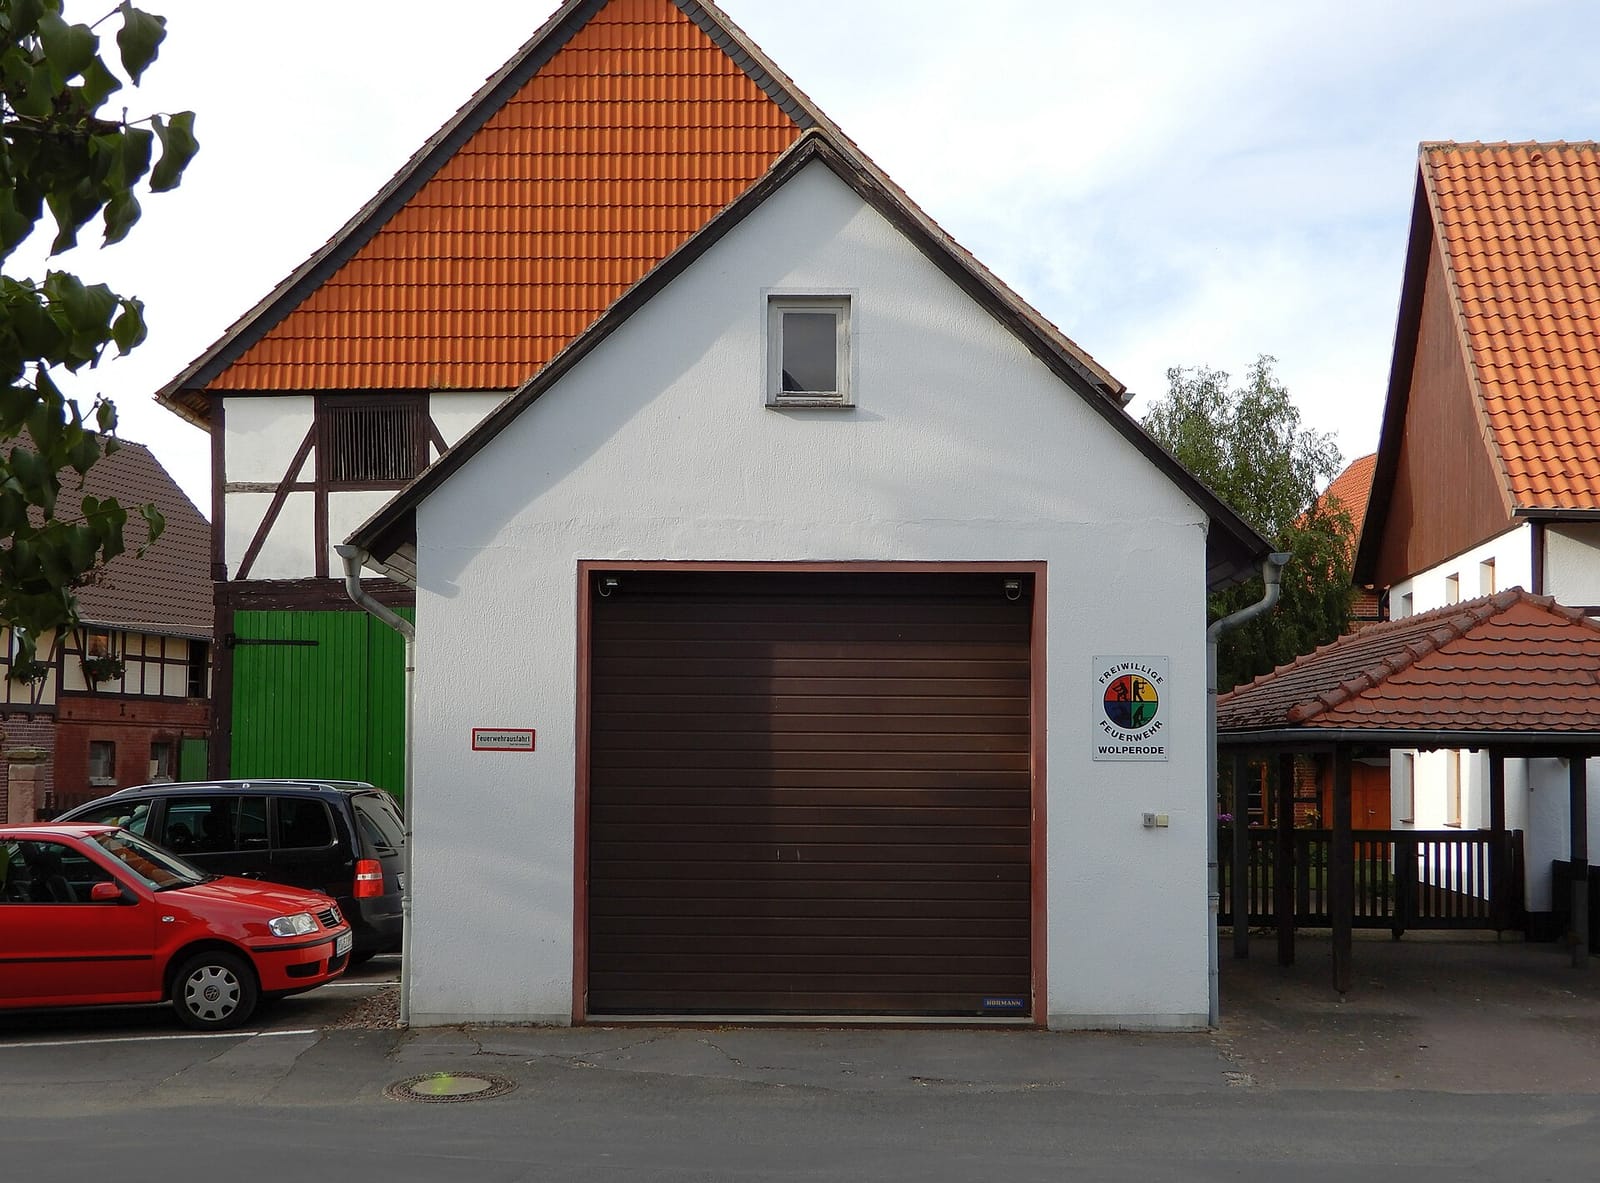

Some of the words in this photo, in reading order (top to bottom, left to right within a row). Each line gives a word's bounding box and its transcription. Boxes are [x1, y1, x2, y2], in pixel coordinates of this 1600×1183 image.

[1098, 662, 1165, 685] FREIWILLIGE
[476, 734, 530, 743] Feuerwehrausfahrt
[1098, 720, 1164, 742] FEUERWEHR
[1097, 745, 1165, 755] WOLPERODE
